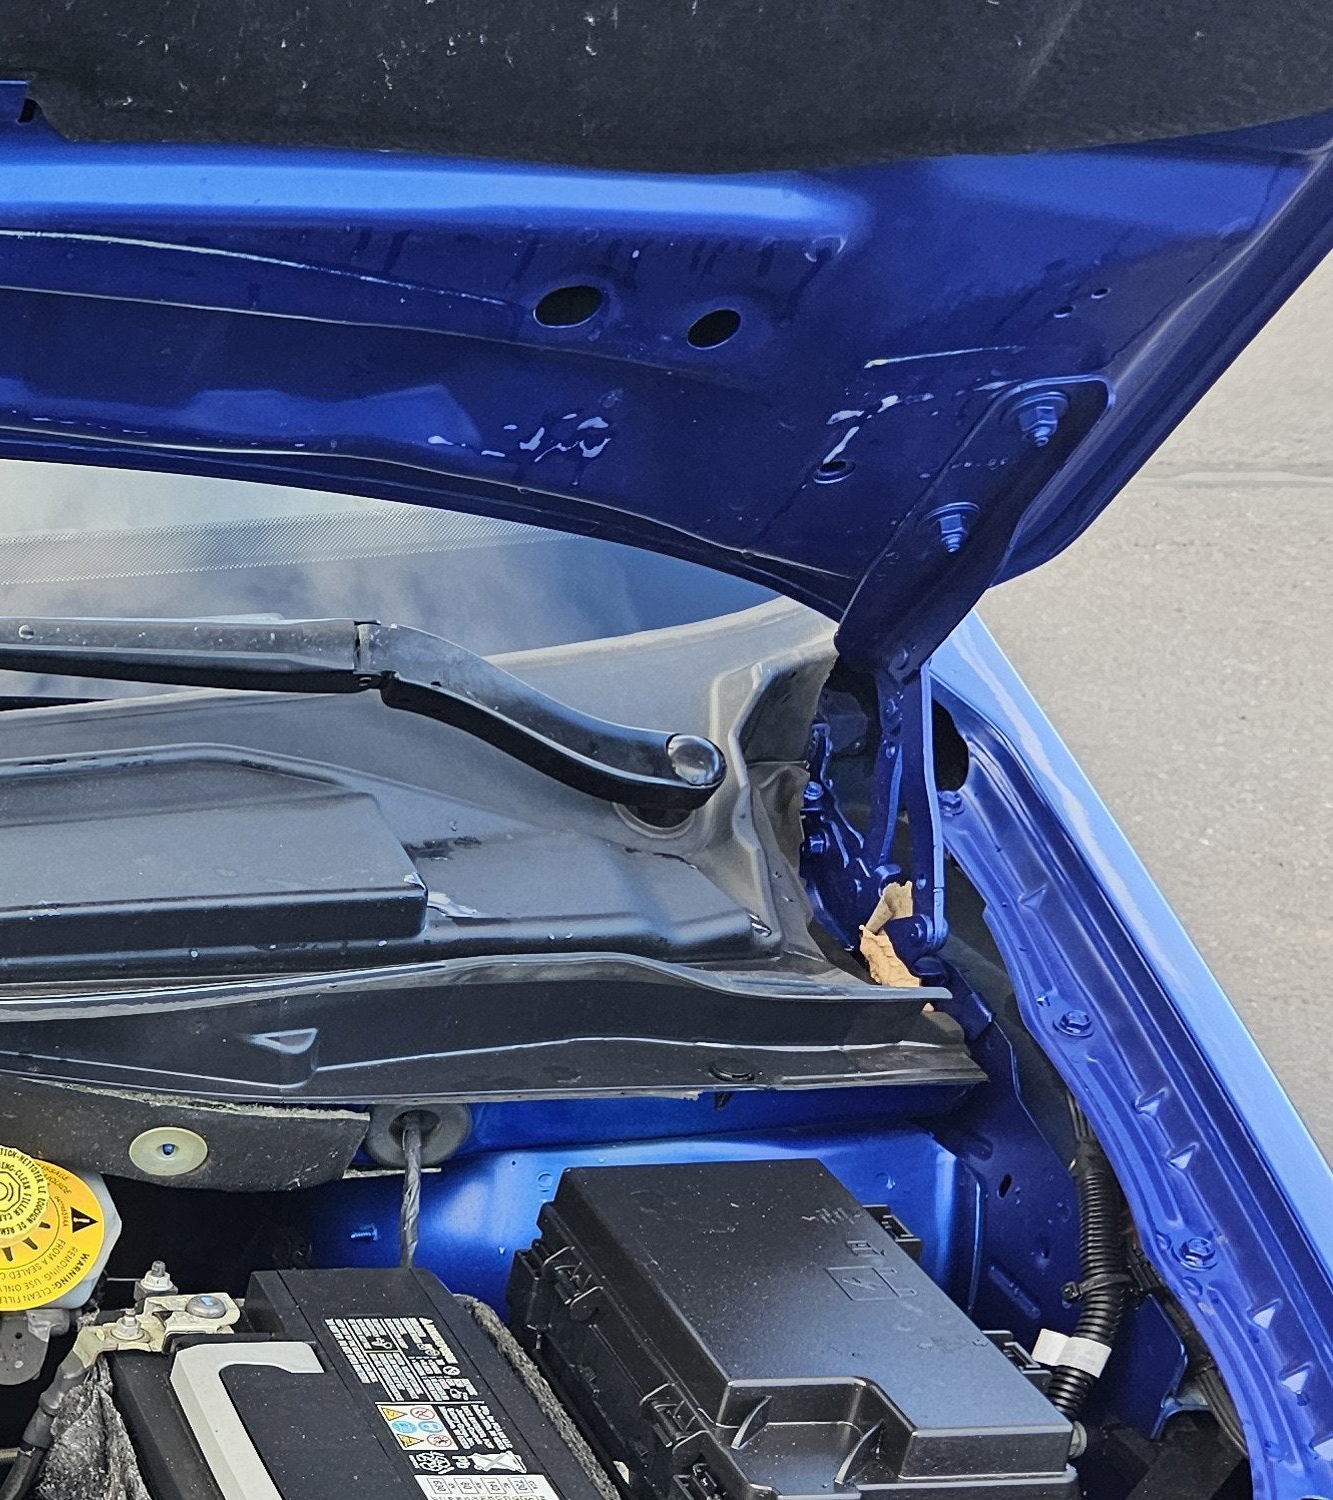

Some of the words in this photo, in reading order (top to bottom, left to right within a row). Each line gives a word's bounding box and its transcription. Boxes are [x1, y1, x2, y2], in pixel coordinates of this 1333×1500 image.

[48, 1238, 66, 1261] FROM
[8, 1262, 43, 1279] SEALED
[53, 1252, 91, 1289] WARNING:
[25, 1277, 42, 1290] USE
[23, 1286, 52, 1302] CLEAN
